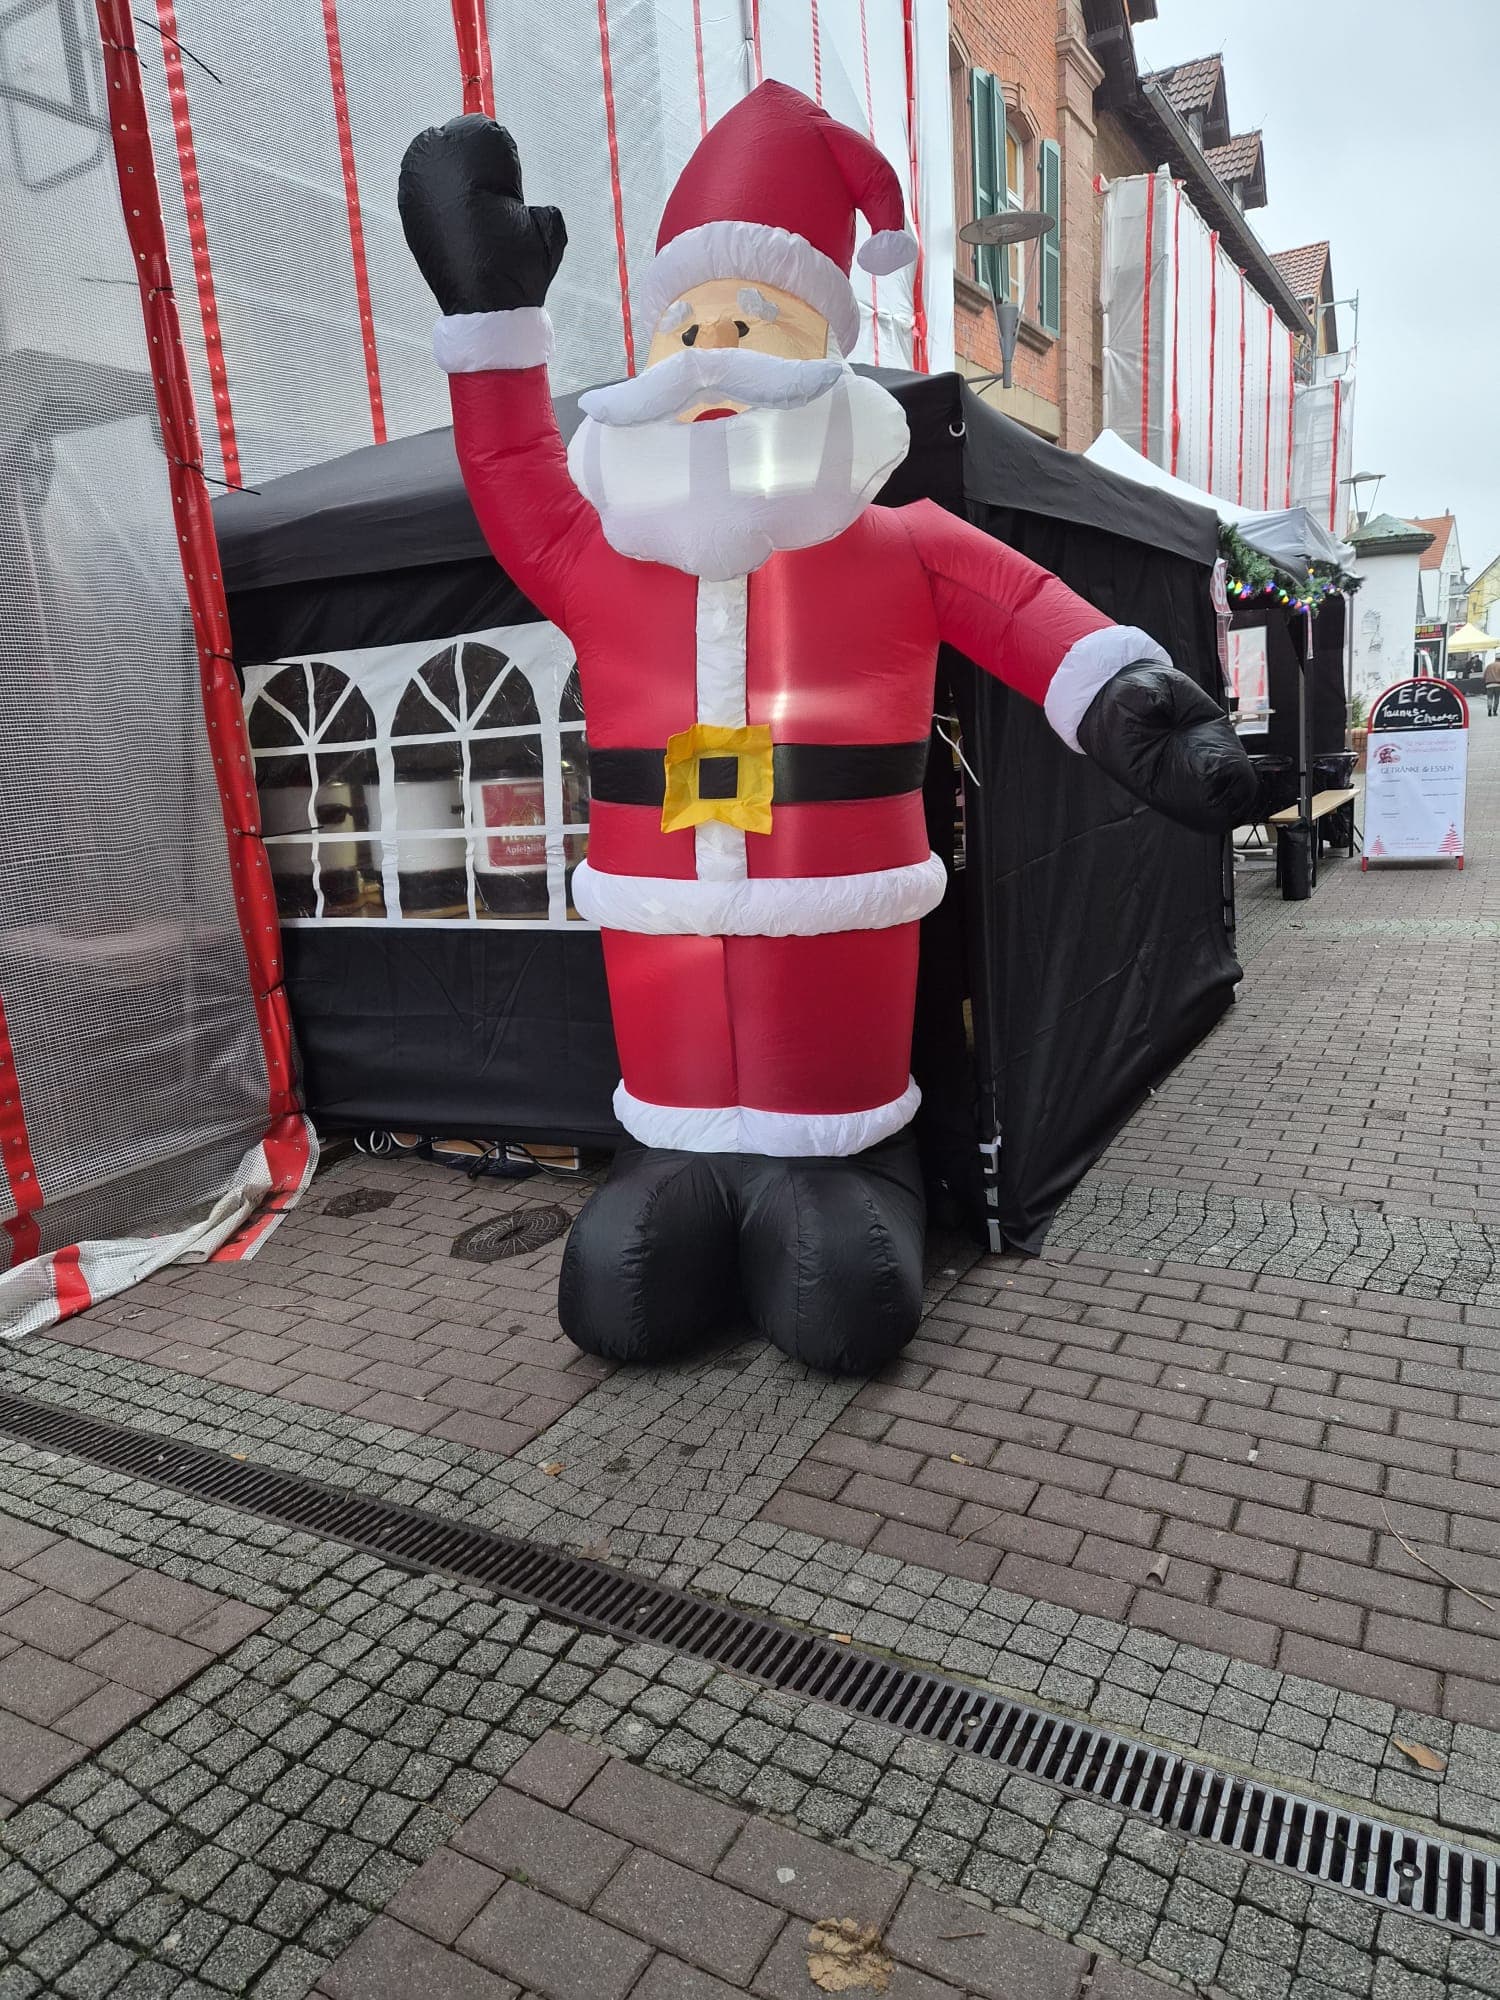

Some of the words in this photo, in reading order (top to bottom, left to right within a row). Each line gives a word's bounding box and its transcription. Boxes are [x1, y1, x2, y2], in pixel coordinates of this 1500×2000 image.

[1398, 686, 1441, 704] EFC
[1382, 705, 1426, 718] Taunus-
[1381, 766, 1419, 774] GETRÄNKE
[1430, 765, 1454, 773] ESSEN
